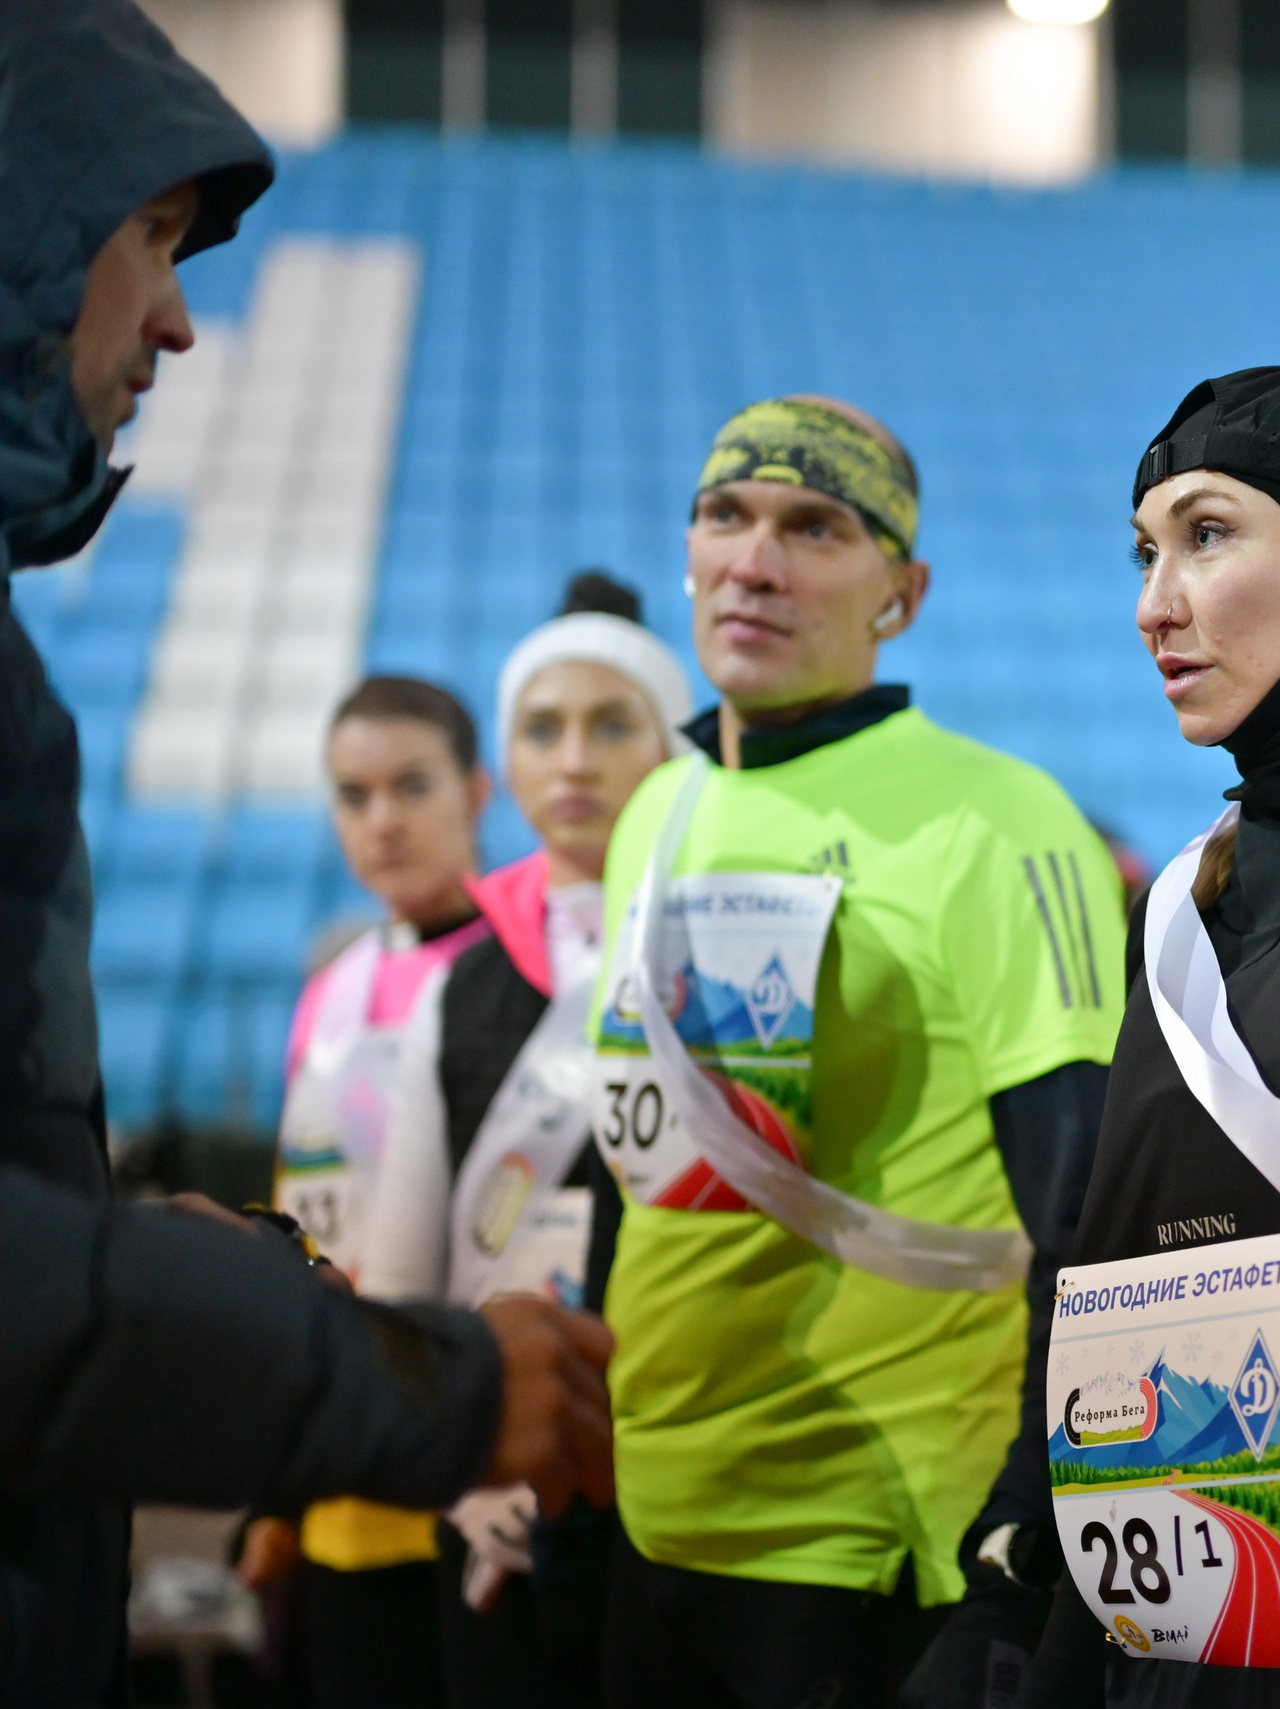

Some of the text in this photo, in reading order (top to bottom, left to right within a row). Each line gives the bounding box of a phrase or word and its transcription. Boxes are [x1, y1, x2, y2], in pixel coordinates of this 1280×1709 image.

[1157, 1213, 1236, 1246] RUNNING
[1058, 1274, 1189, 1319] НОВОГОДНИЕ
[1074, 1404, 1146, 1425] Реформа Бега
